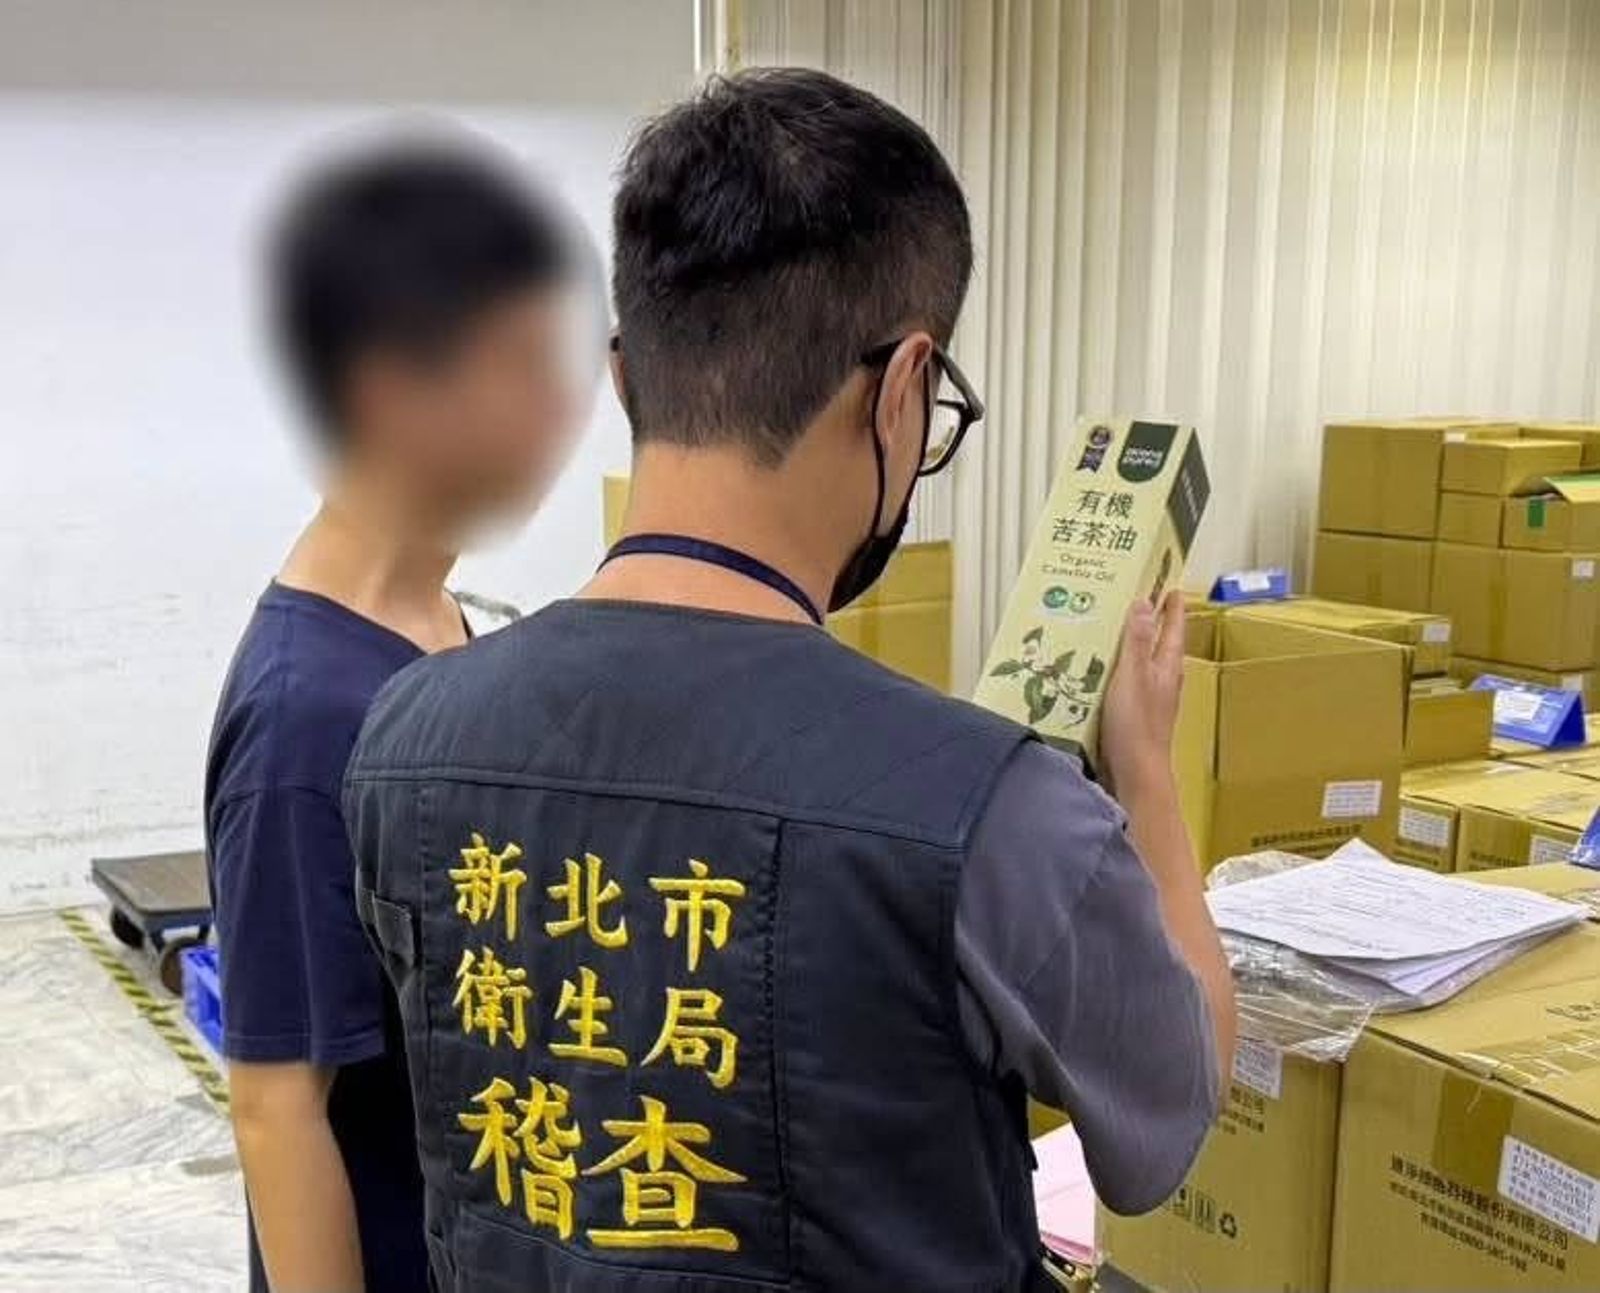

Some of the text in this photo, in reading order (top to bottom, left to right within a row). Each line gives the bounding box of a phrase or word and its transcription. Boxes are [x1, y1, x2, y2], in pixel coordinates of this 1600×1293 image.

[1052, 518, 1138, 551] 苦茶油
[1076, 489, 1134, 519] 有機
[449, 832, 746, 972] 新北市
[452, 946, 739, 1089] 衛生局
[458, 1076, 748, 1251] 稽查
